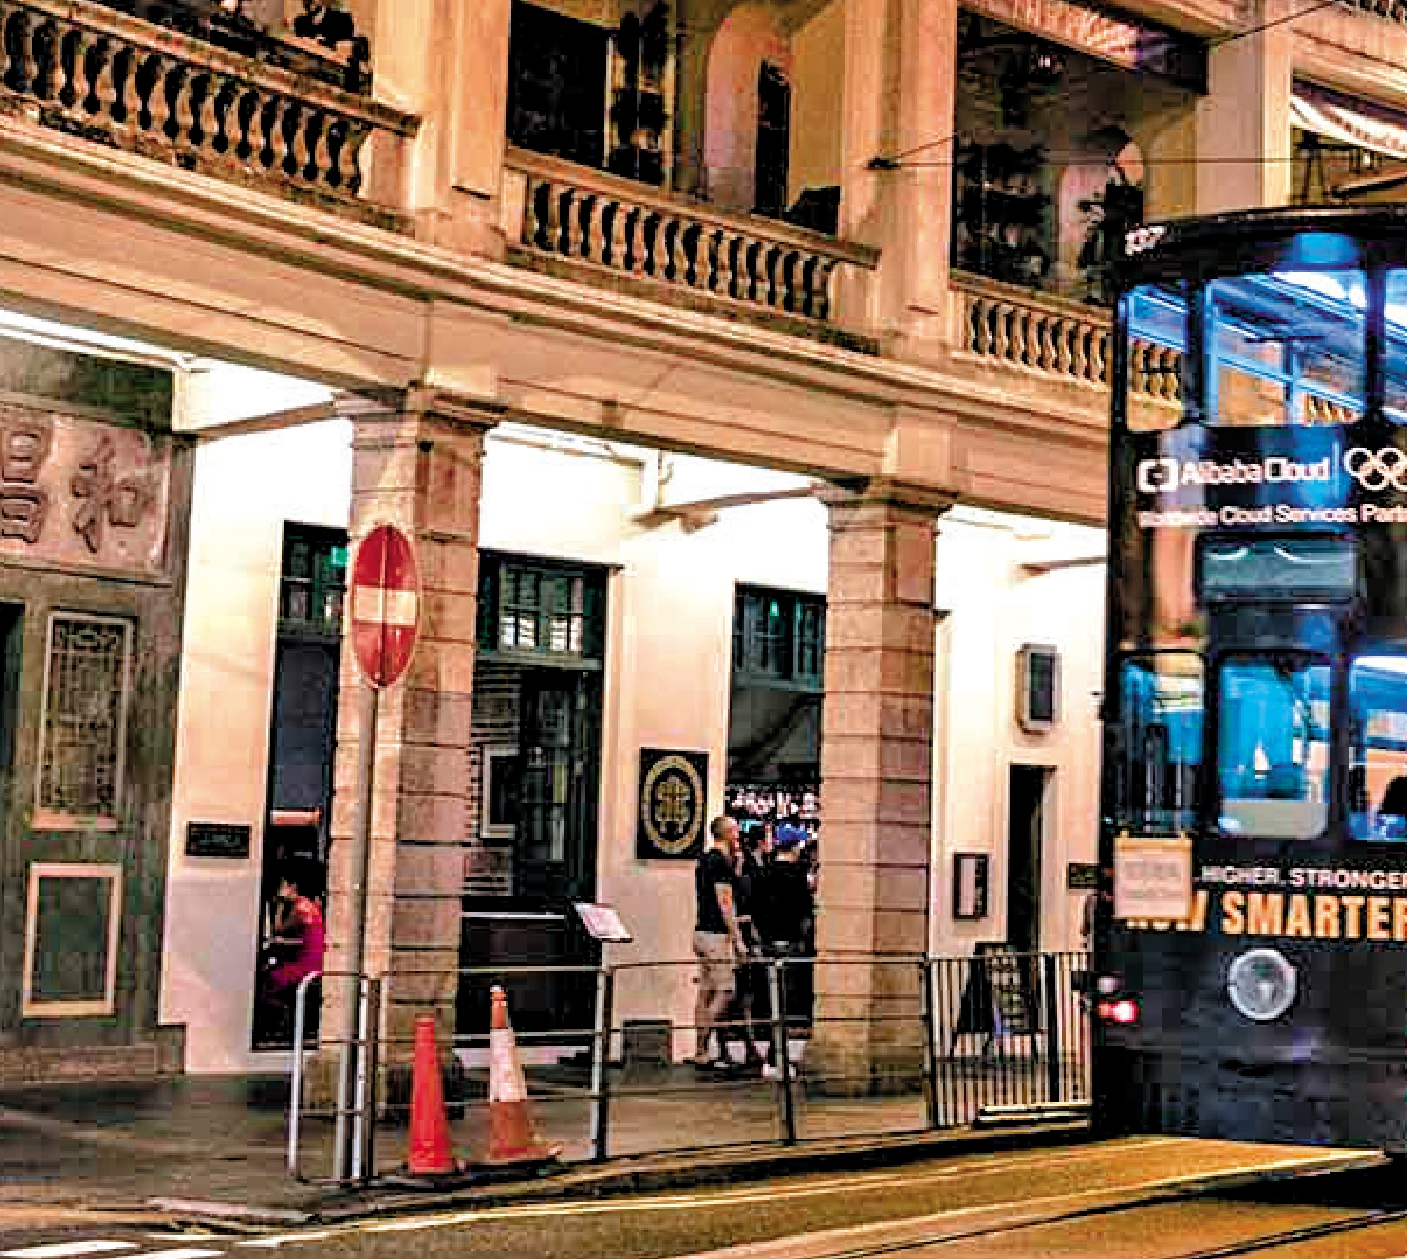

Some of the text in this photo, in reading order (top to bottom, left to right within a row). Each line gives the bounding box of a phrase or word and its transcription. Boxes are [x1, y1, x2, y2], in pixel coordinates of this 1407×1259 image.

[1180, 457, 1331, 486] Alibaba Cloud
[1220, 506, 1273, 524] Cloud
[1274, 504, 1358, 524] Services
[1201, 866, 1284, 886] HIGHER.
